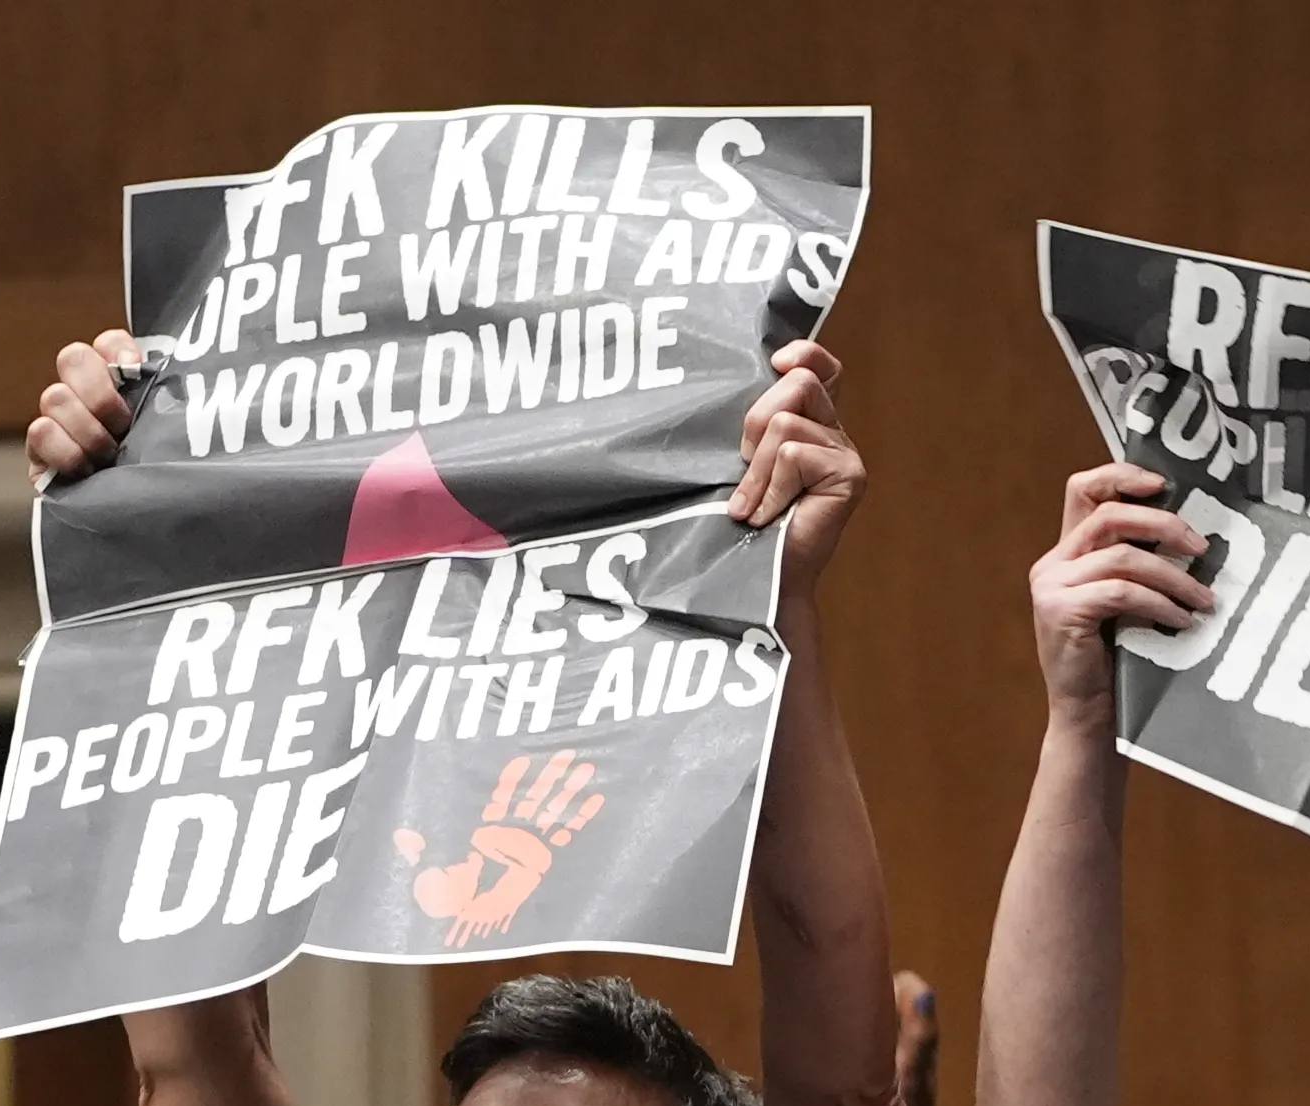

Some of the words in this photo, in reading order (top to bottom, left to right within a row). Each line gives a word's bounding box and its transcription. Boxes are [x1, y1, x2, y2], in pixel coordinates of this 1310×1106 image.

[426, 118, 765, 229] KILLS
[139, 240, 370, 362] OPLE
[399, 216, 607, 321] WITH
[639, 223, 849, 308] AIDS
[186, 297, 688, 458] WORLDWIDE
[148, 570, 388, 705] RFK
[398, 532, 647, 662] LIES
[7, 692, 326, 822] PEOPLE
[352, 654, 566, 748] WITH
[576, 627, 779, 726] AIDS
[118, 751, 369, 943] DIE
